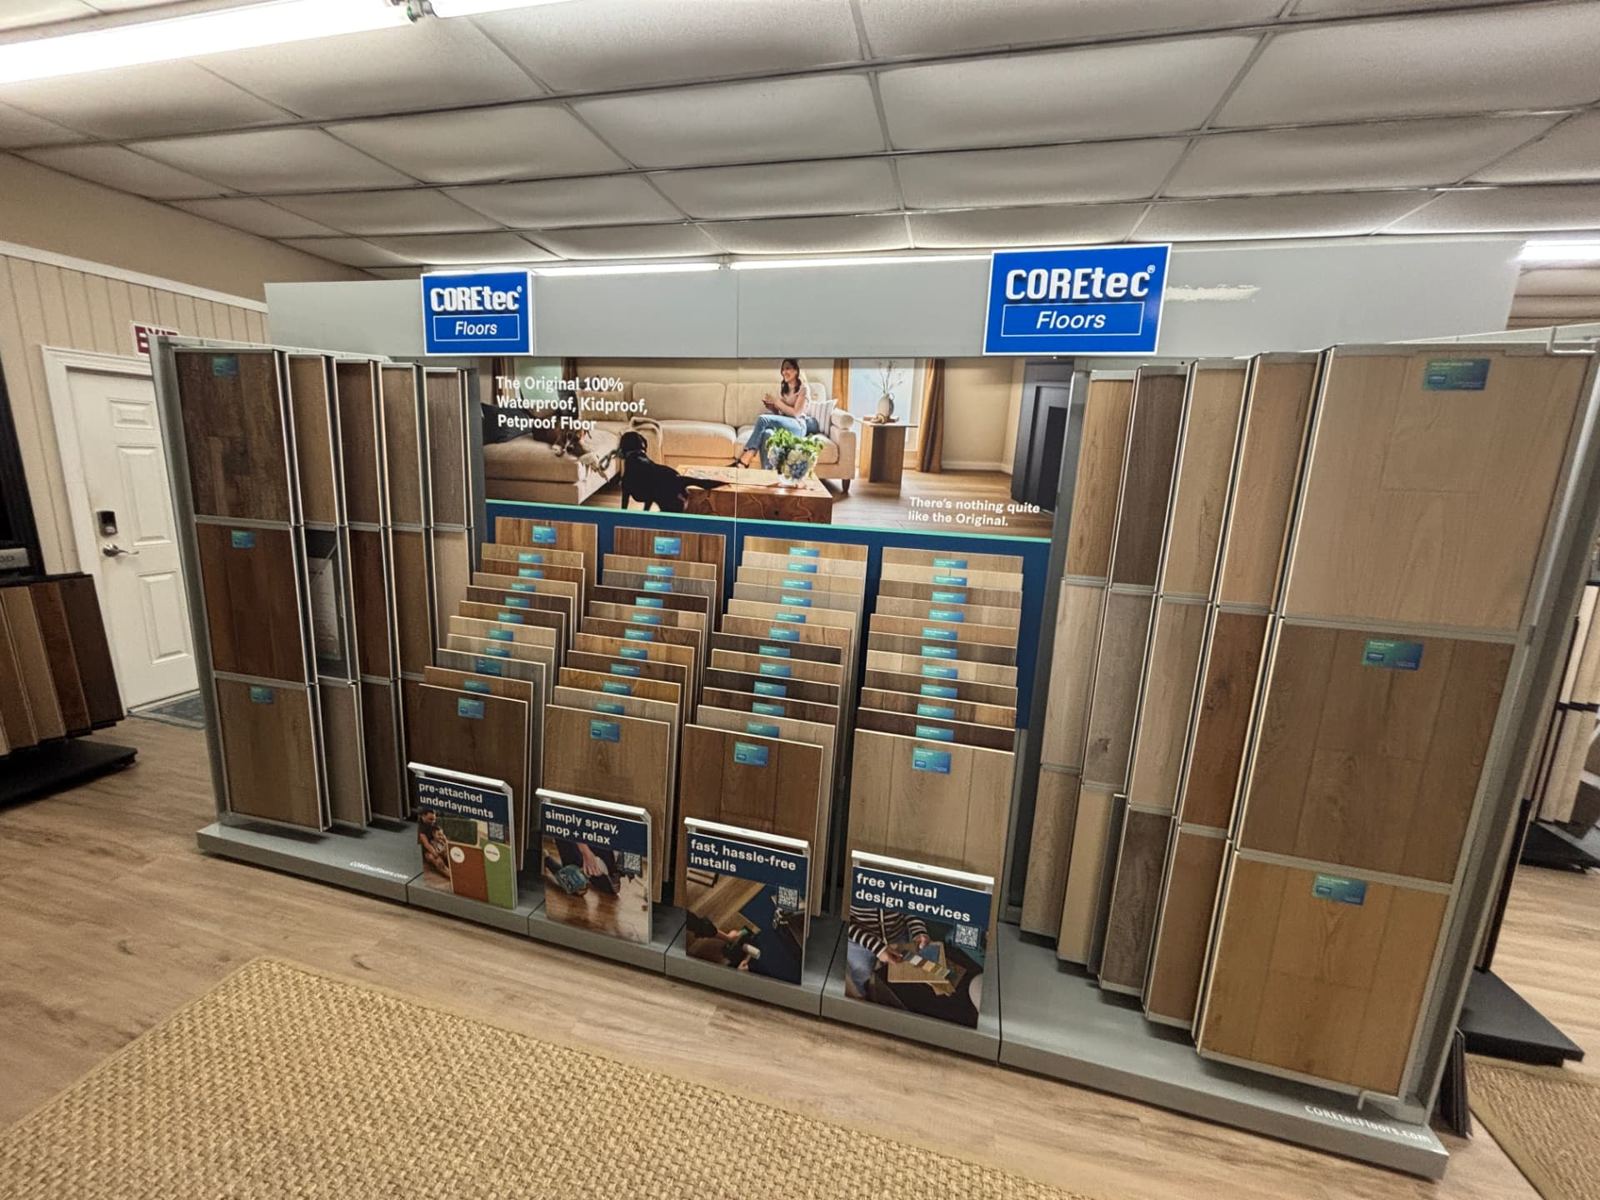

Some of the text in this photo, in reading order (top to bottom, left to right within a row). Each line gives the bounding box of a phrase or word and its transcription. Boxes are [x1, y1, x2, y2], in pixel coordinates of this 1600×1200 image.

[455, 320, 498, 336] Floors
[1036, 311, 1107, 329] Floors
[496, 376, 624, 393] The Original 100%
[496, 395, 648, 415] Waterproof, Kidproof,
[498, 414, 557, 430] Petproof
[909, 496, 1041, 514] There's nothing quite
[908, 510, 1008, 527] like the Original.
[418, 783, 483, 803] pre-attached
[420, 796, 494, 819] underlayments
[545, 809, 619, 834] simply spray,
[546, 824, 611, 845] mop + relax
[690, 839, 797, 871] fast, hassle-free
[690, 853, 737, 872] installs
[856, 873, 937, 899] free virtual
[855, 889, 971, 922] design services
